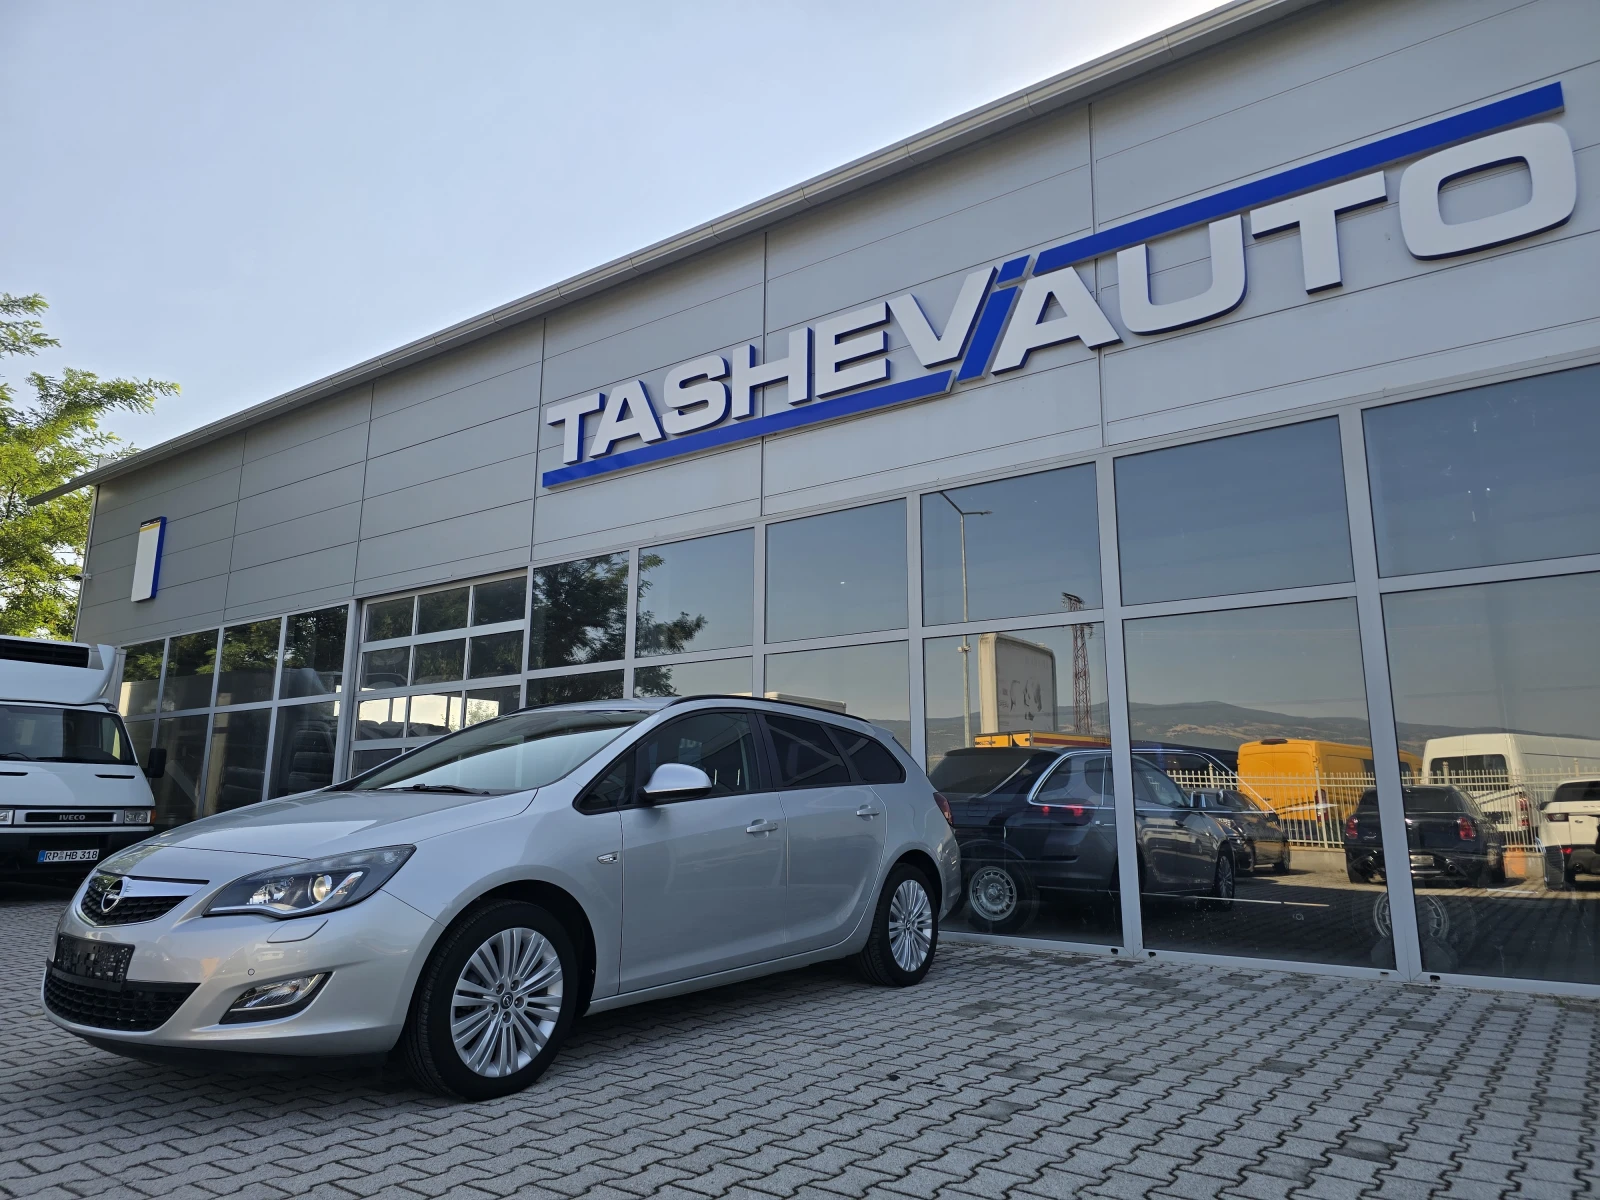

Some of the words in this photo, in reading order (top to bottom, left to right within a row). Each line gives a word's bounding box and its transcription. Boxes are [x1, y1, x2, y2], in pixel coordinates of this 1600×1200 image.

[44, 852, 59, 861] RP
[64, 851, 78, 860] HB
[79, 851, 98, 860] 318
